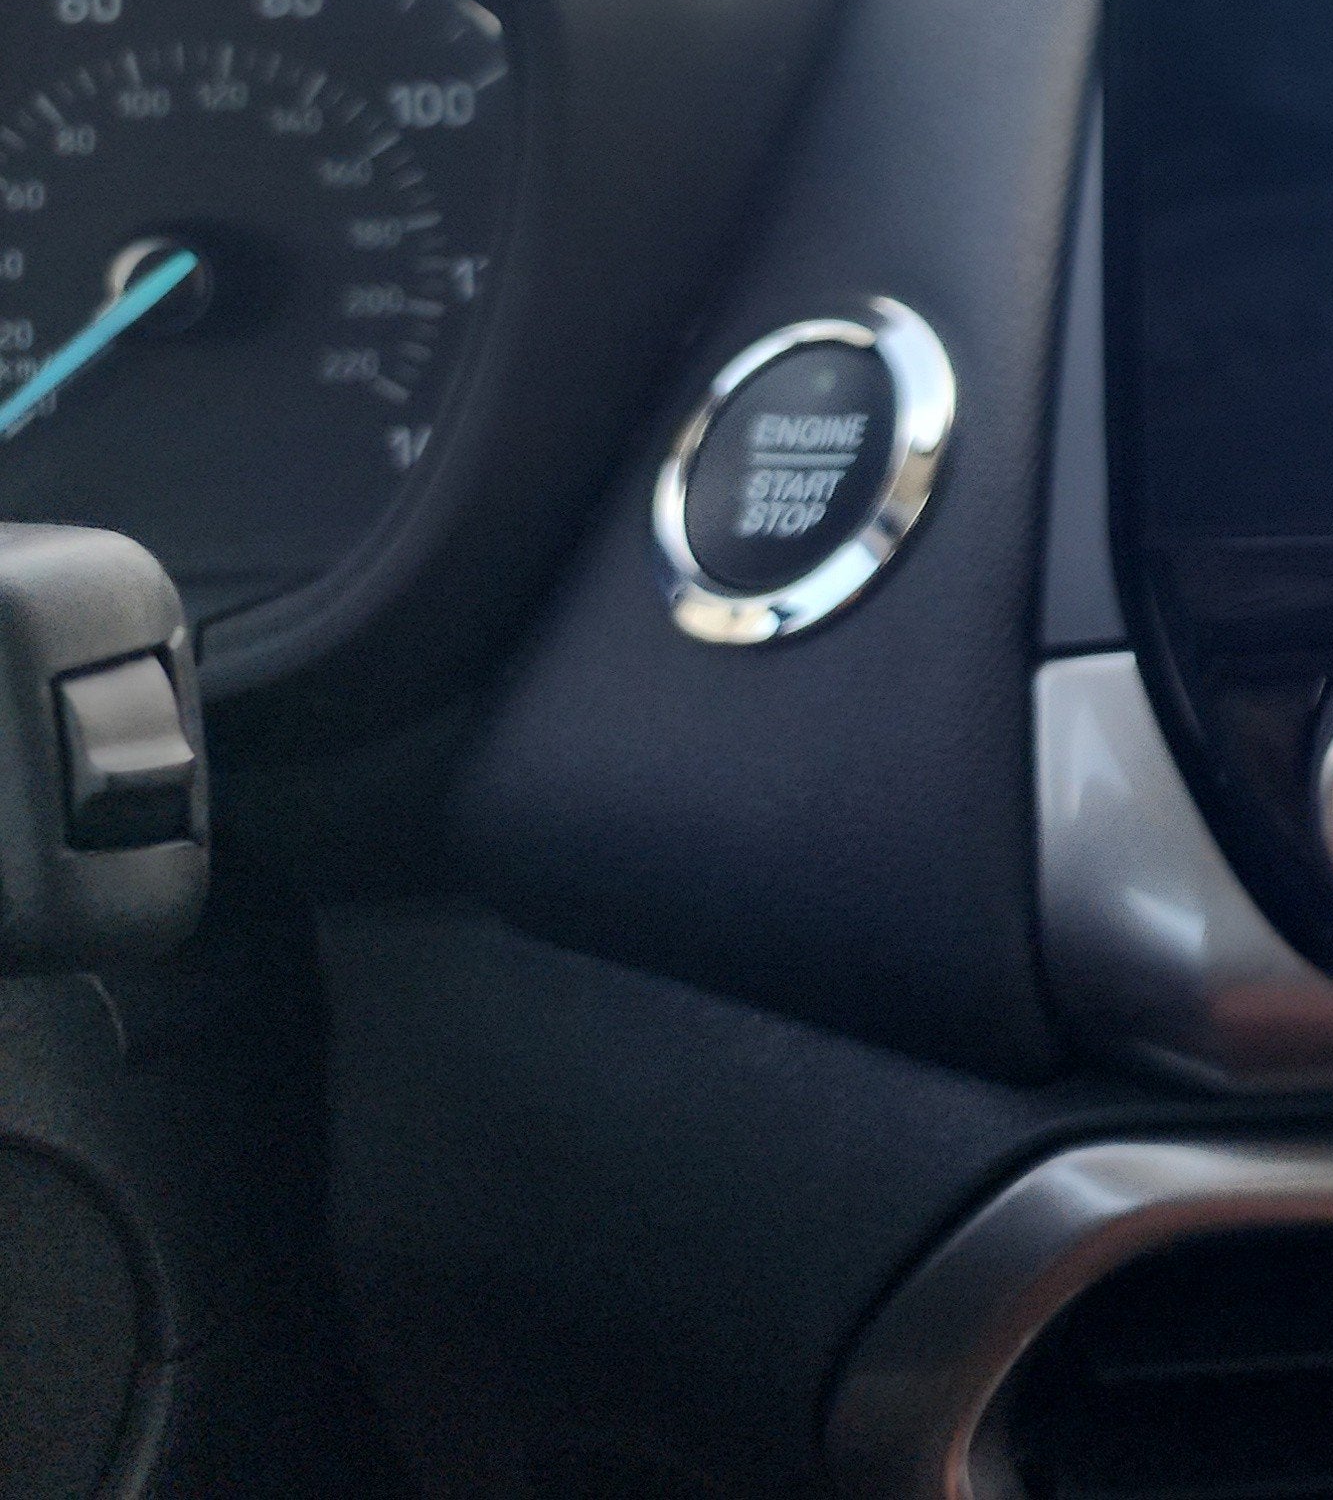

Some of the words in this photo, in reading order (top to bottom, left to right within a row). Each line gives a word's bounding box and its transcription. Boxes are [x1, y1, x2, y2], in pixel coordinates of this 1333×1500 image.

[392, 83, 475, 128] 100
[752, 413, 869, 448] ENGINE
[743, 470, 847, 502] START
[737, 503, 828, 537] STOP
